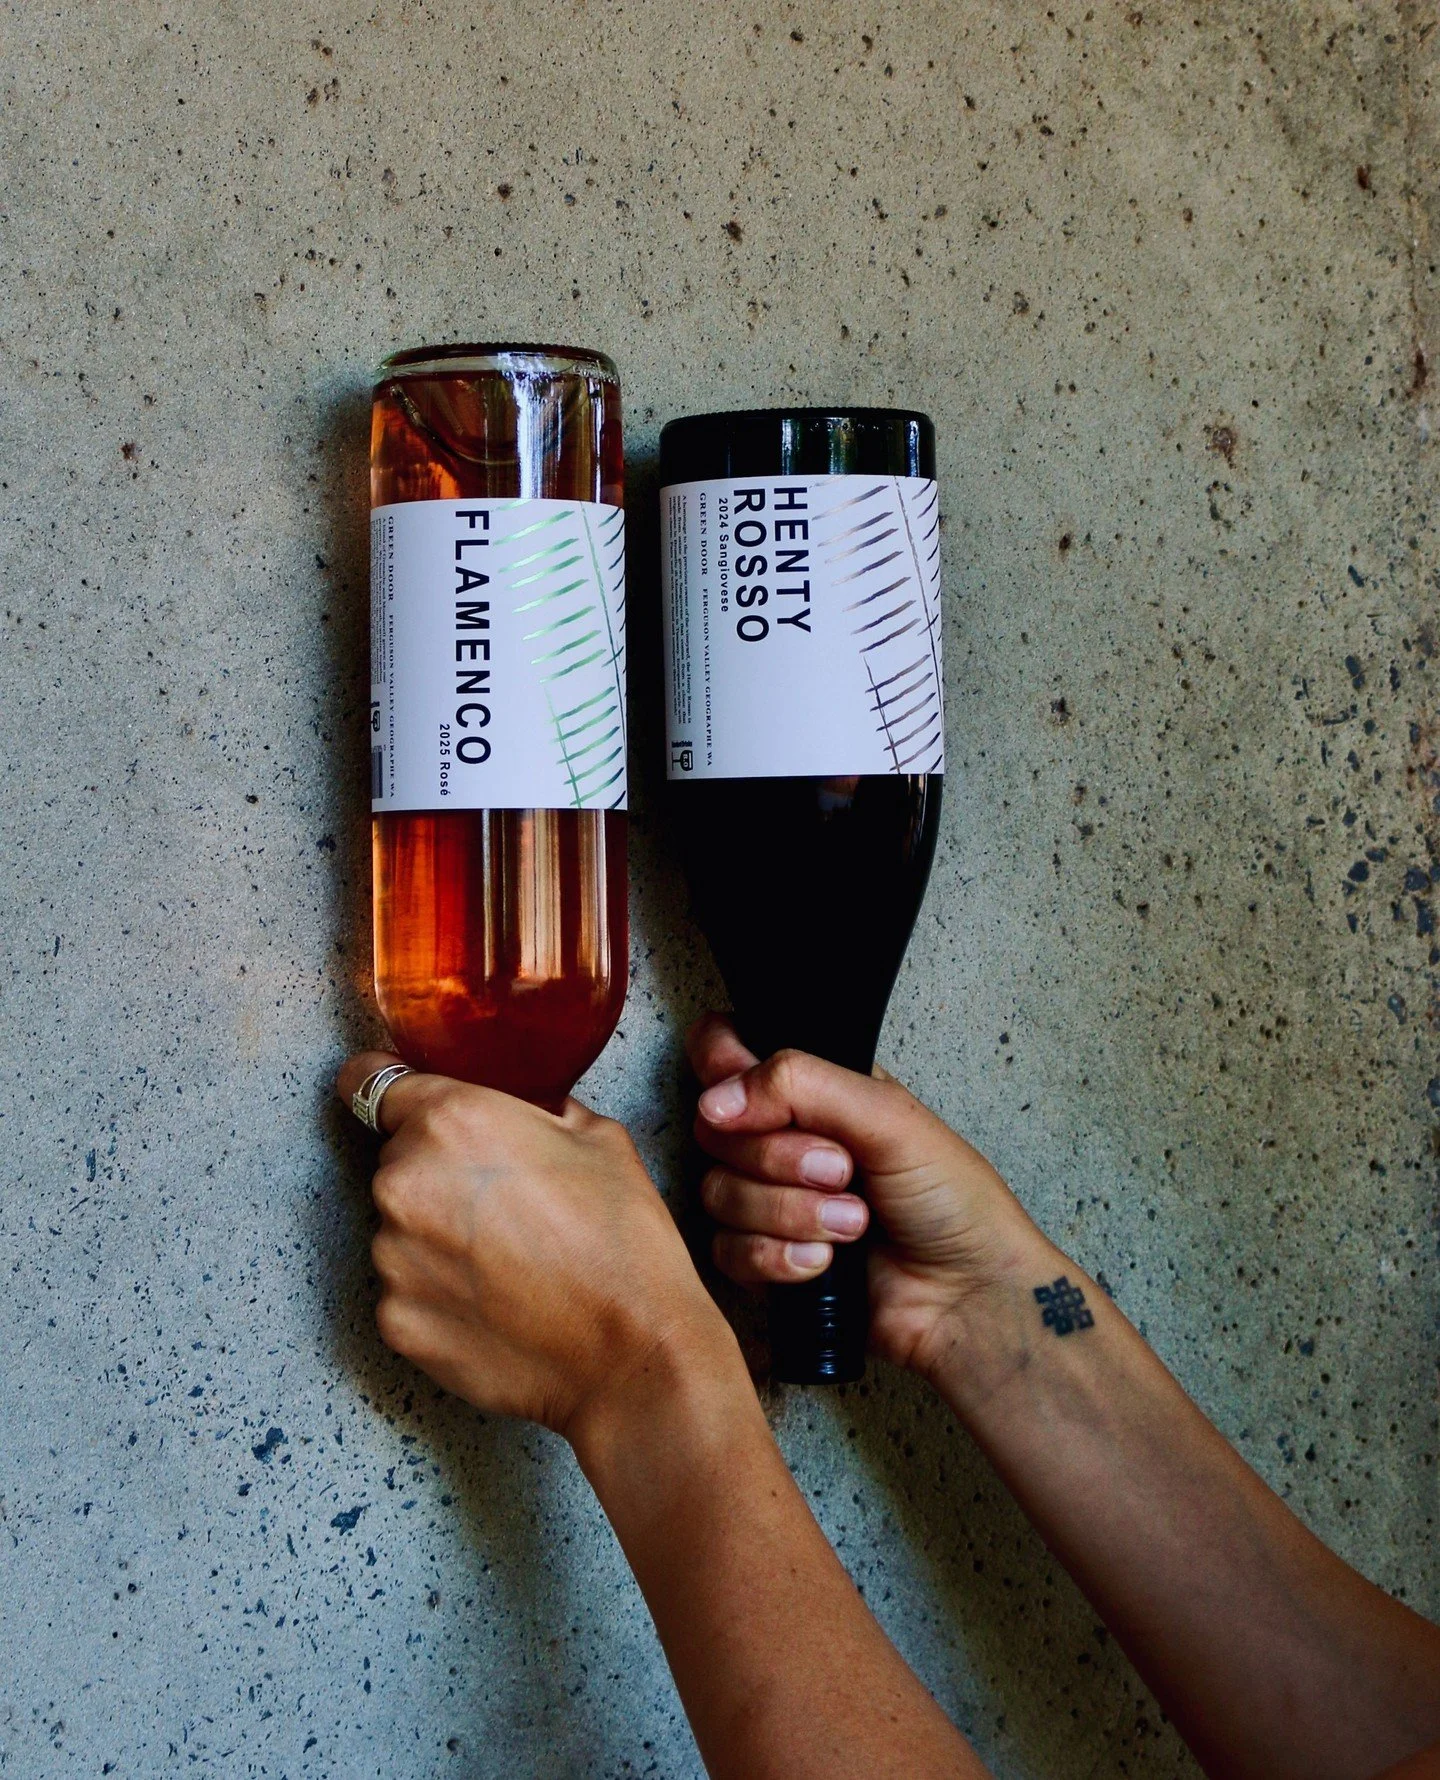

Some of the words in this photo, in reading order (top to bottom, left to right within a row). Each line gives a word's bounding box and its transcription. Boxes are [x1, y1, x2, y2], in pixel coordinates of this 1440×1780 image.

[719, 498, 728, 528] 2024
[718, 535, 729, 612] Sangiovese
[733, 488, 770, 643] ROSSO
[774, 487, 811, 633] HENTY
[455, 510, 491, 766] FLAMENCO
[439, 723, 450, 756] 2025
[708, 752, 712, 765] WA
[391, 783, 394, 797] WA
[439, 761, 451, 796] Rosé
